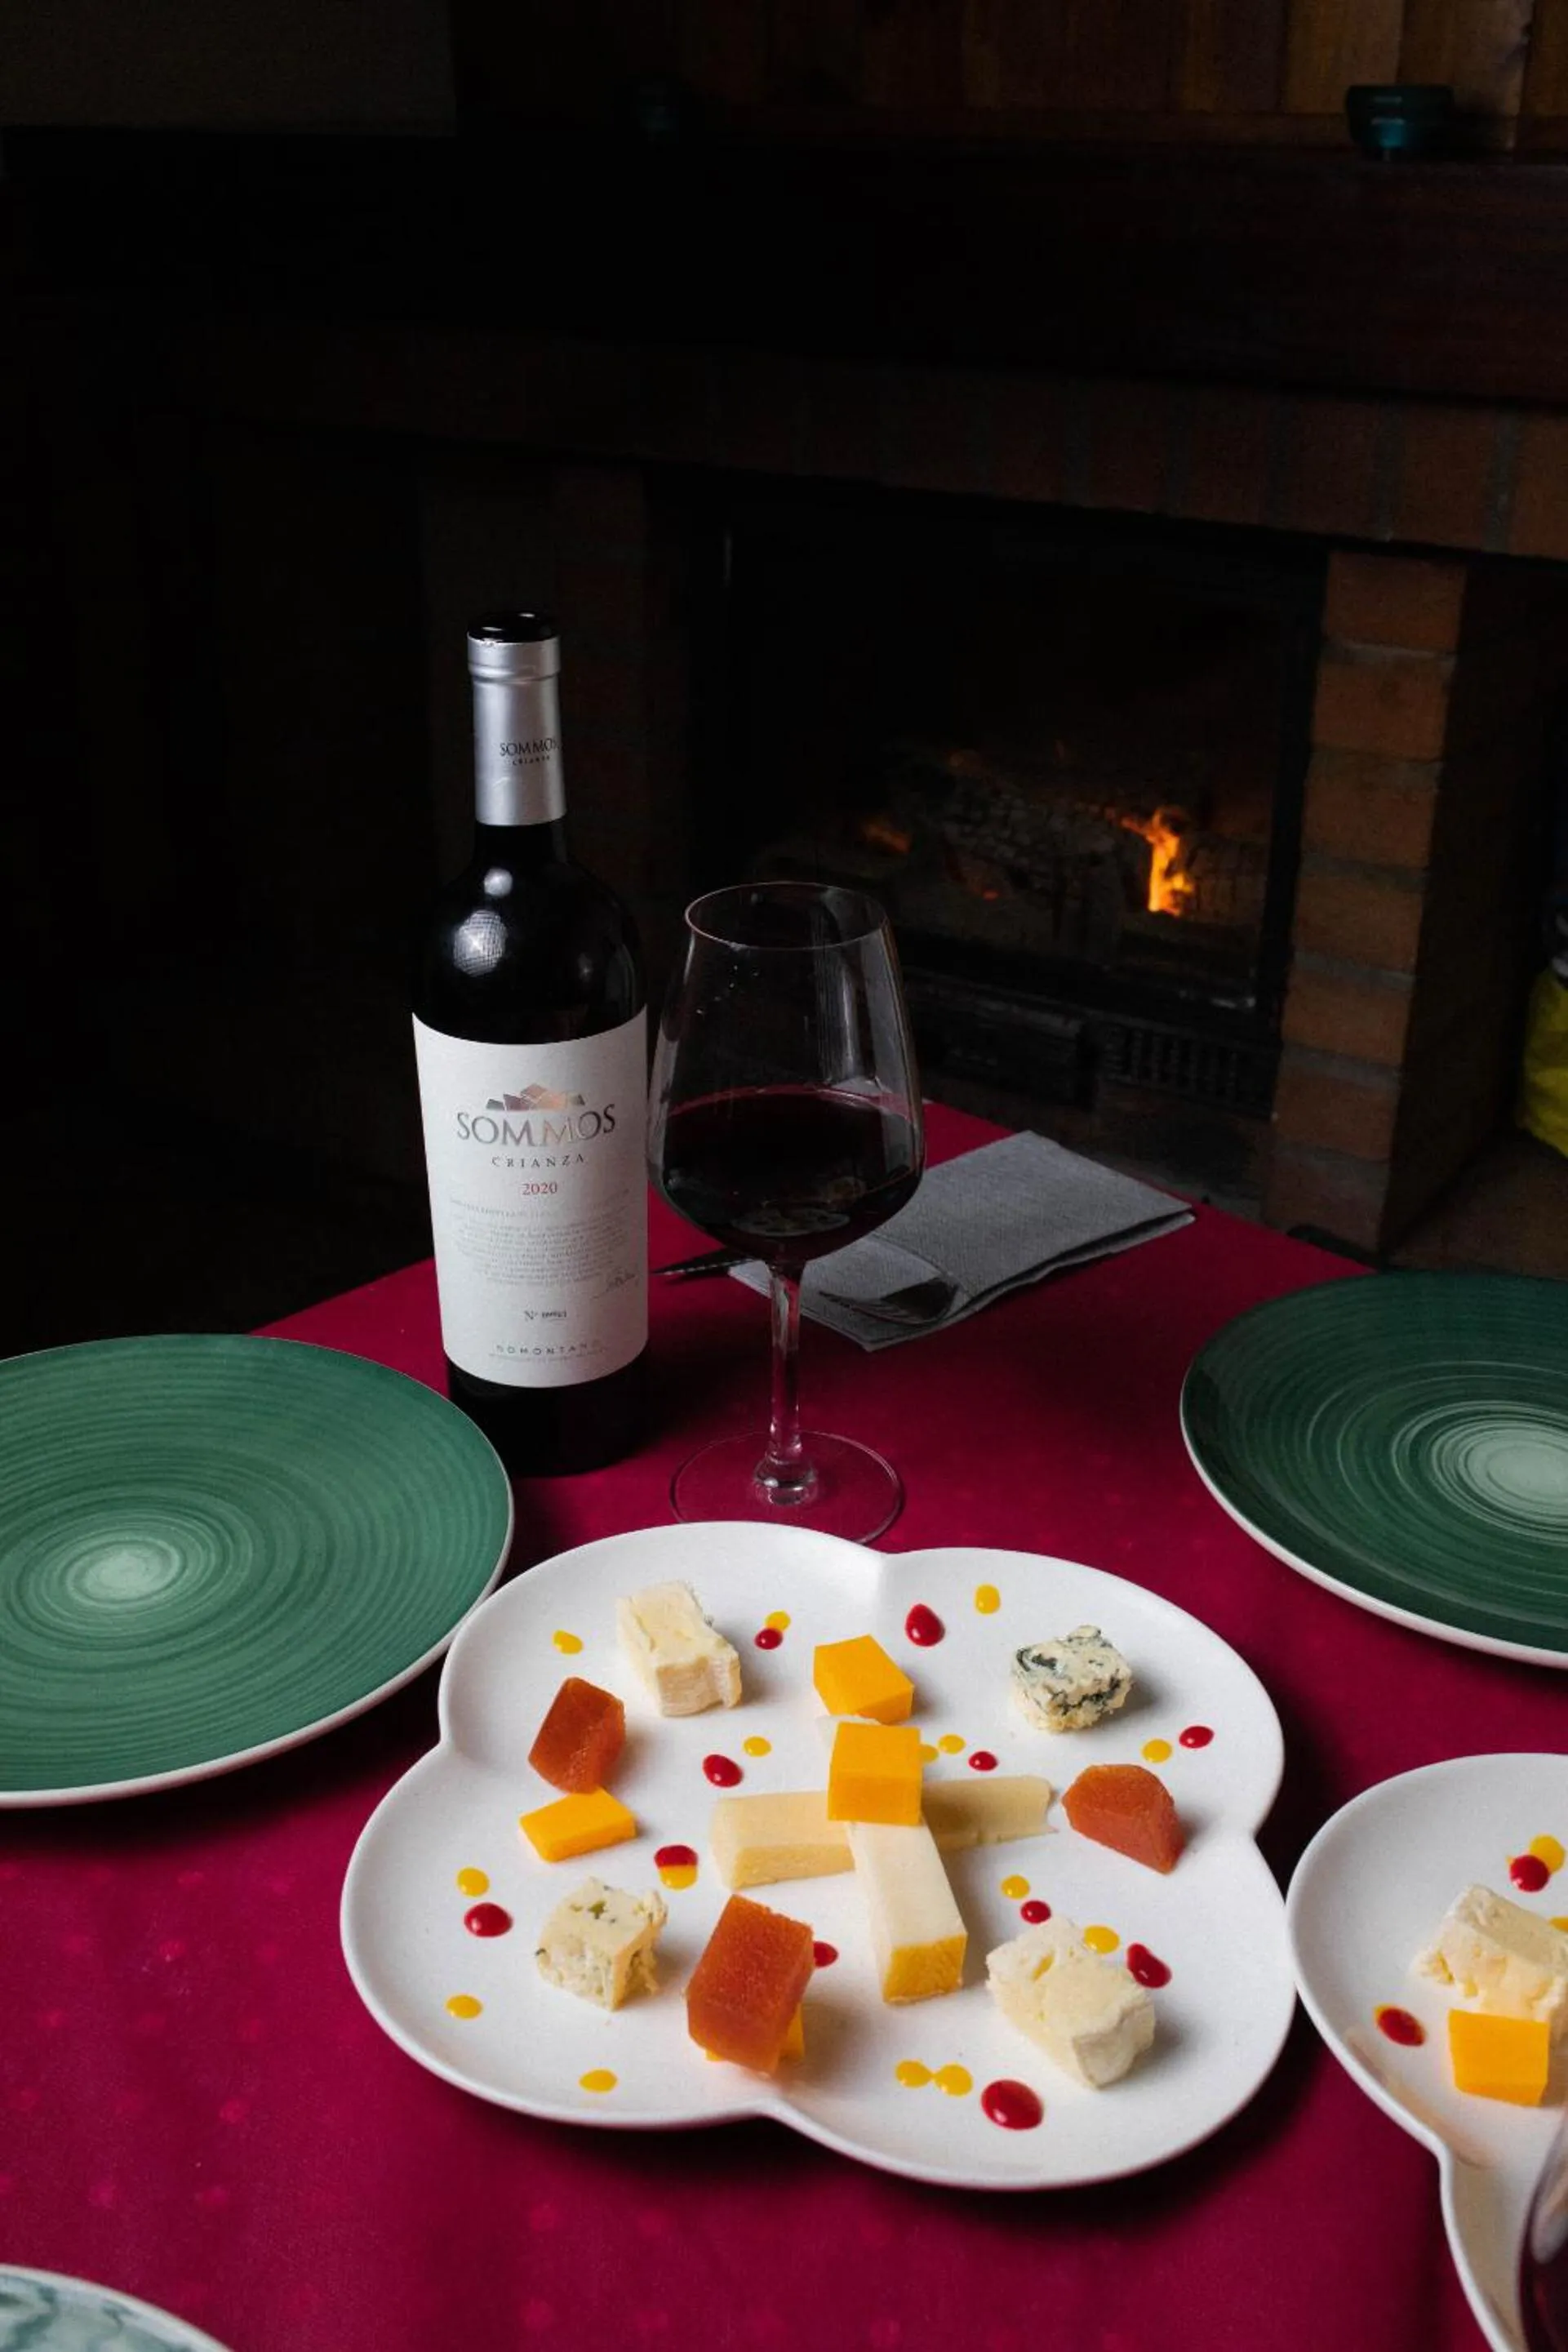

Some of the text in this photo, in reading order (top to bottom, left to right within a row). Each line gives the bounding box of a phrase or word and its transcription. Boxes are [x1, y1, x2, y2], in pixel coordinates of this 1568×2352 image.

[456, 1103, 616, 1147] SOMMOS
[491, 1154, 584, 1168] CRIANZA
[522, 1181, 558, 1196] 2020
